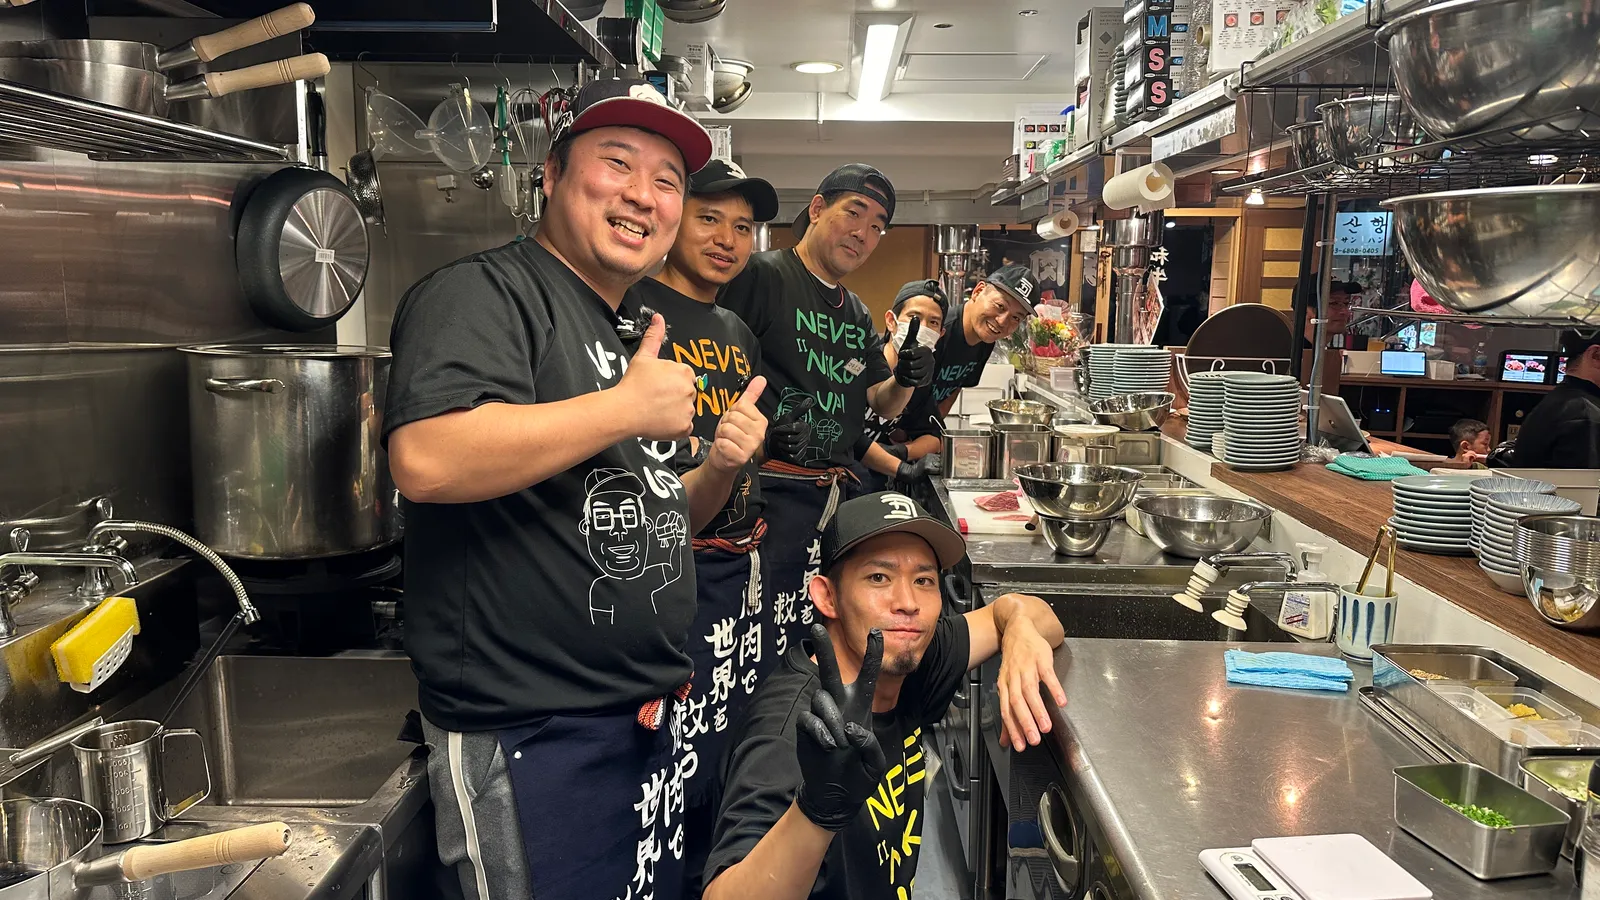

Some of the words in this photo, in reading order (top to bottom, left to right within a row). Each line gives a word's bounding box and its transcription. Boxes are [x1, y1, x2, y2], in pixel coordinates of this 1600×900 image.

[1147, 14, 1169, 37] M
[1148, 47, 1166, 71] S
[1150, 81, 1167, 104] S
[796, 308, 866, 350] NEVER
[773, 591, 797, 656] 救う
[703, 616, 738, 733] 世界を
